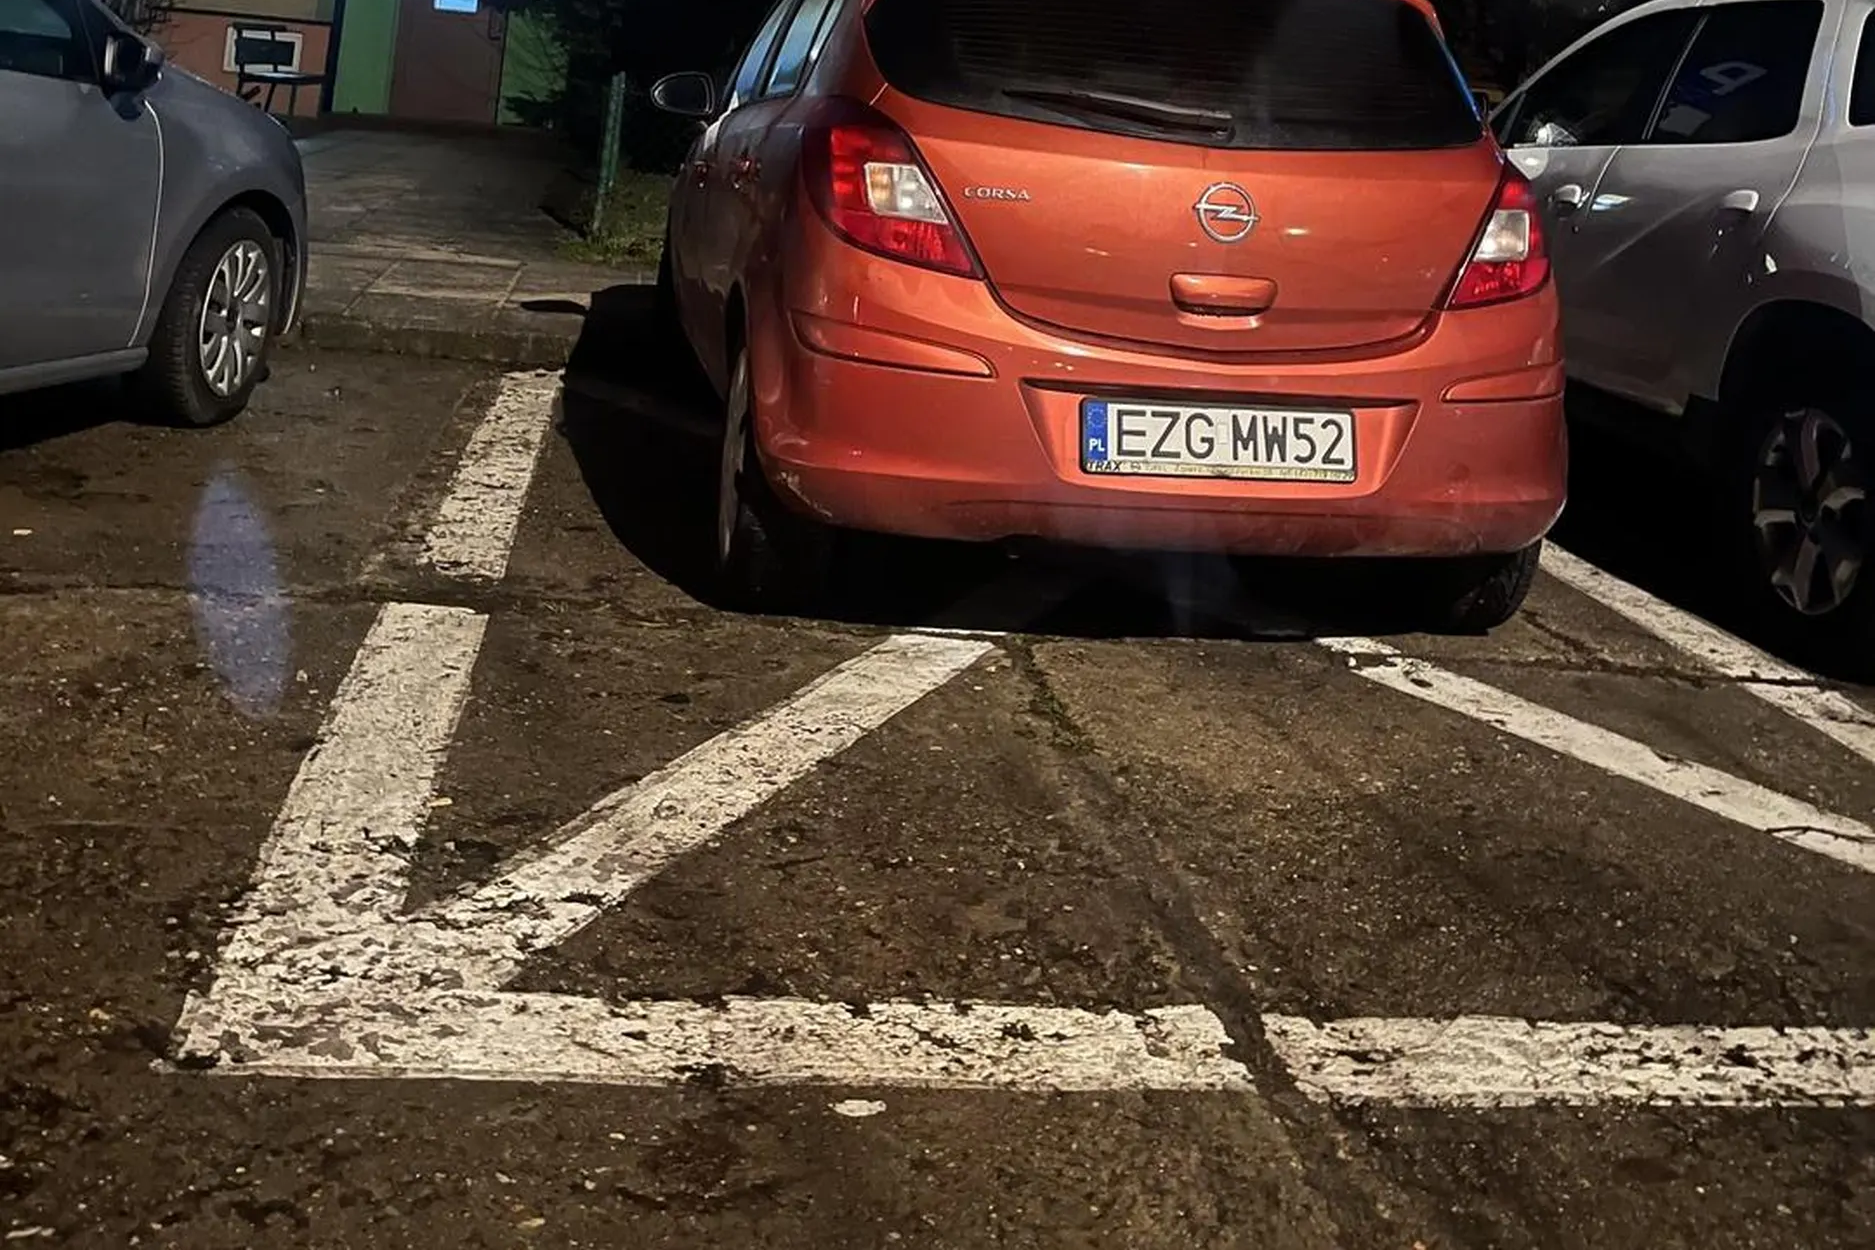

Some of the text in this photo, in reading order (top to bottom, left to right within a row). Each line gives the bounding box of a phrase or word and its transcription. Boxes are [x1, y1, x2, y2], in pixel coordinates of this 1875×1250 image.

[964, 186, 1031, 201] CORSA
[1089, 437, 1105, 452] PL
[1116, 409, 1345, 465] EZG MW52
